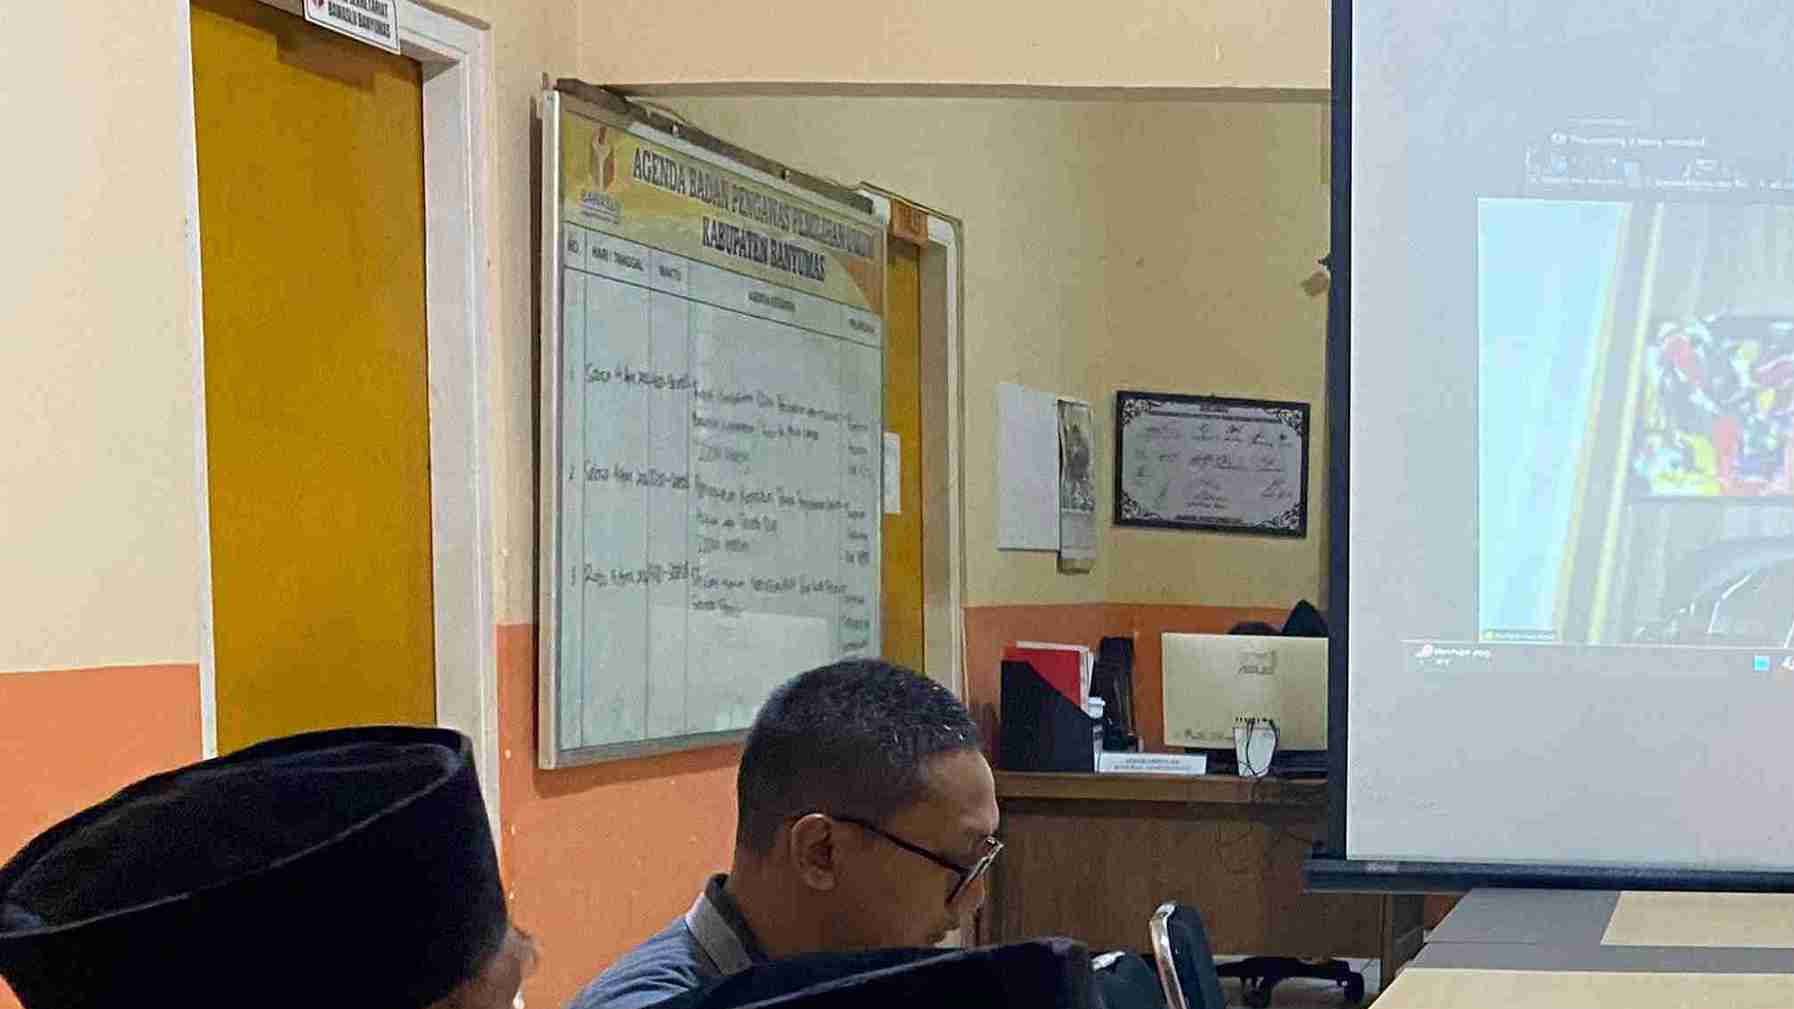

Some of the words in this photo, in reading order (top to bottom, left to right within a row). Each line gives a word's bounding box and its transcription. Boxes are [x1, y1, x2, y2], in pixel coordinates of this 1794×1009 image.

[633, 146, 686, 193] AGENDA
[702, 216, 768, 264] KABUPATEN
[769, 237, 825, 281] BANYUMAS
